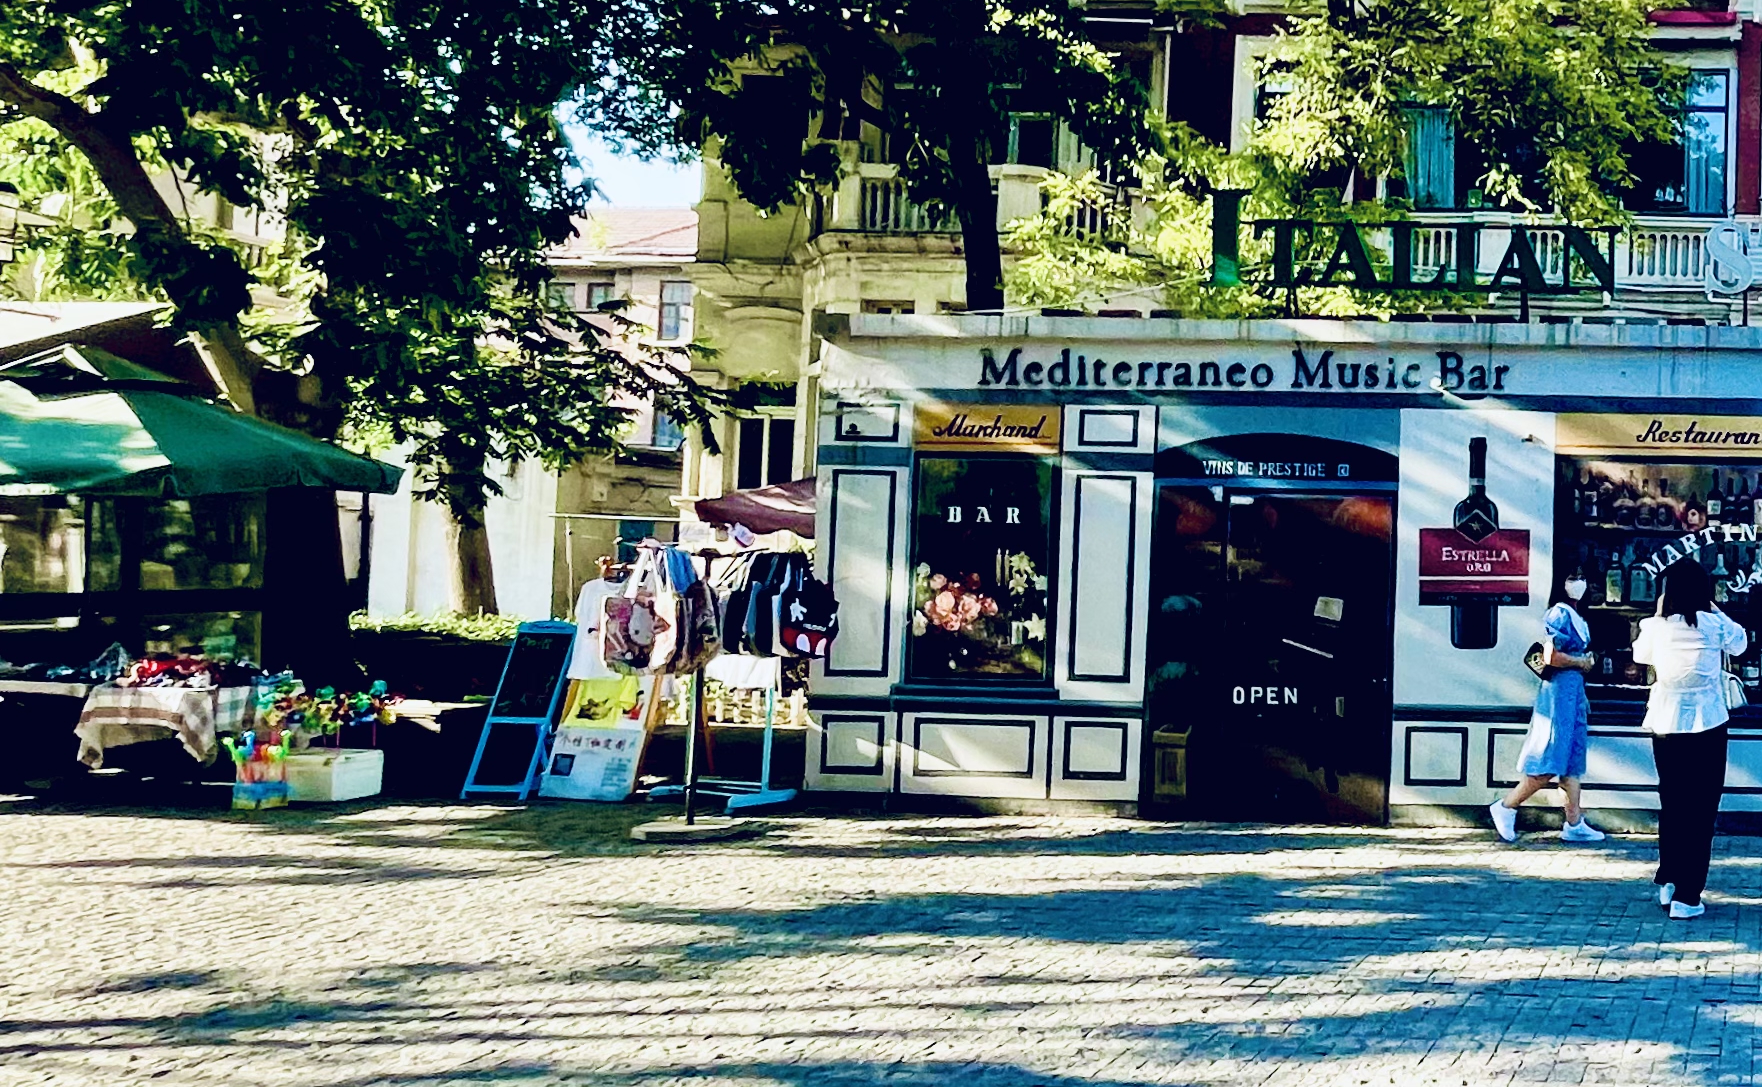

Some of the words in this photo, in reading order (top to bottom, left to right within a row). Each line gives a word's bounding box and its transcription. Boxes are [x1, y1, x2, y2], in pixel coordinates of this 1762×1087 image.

[1202, 188, 1624, 295] ITALIAN
[978, 348, 1274, 390] Mediterraneo
[1290, 348, 1422, 391] Music
[1434, 350, 1510, 391] Bar
[932, 413, 1052, 440] Marchand
[1202, 460, 1234, 476] VINS
[1237, 461, 1253, 476] DE
[1258, 462, 1326, 477] PRESTIGE
[947, 505, 1021, 524] BAR
[1441, 546, 1510, 562] ESTRELLA
[1232, 685, 1298, 705] OPEN
